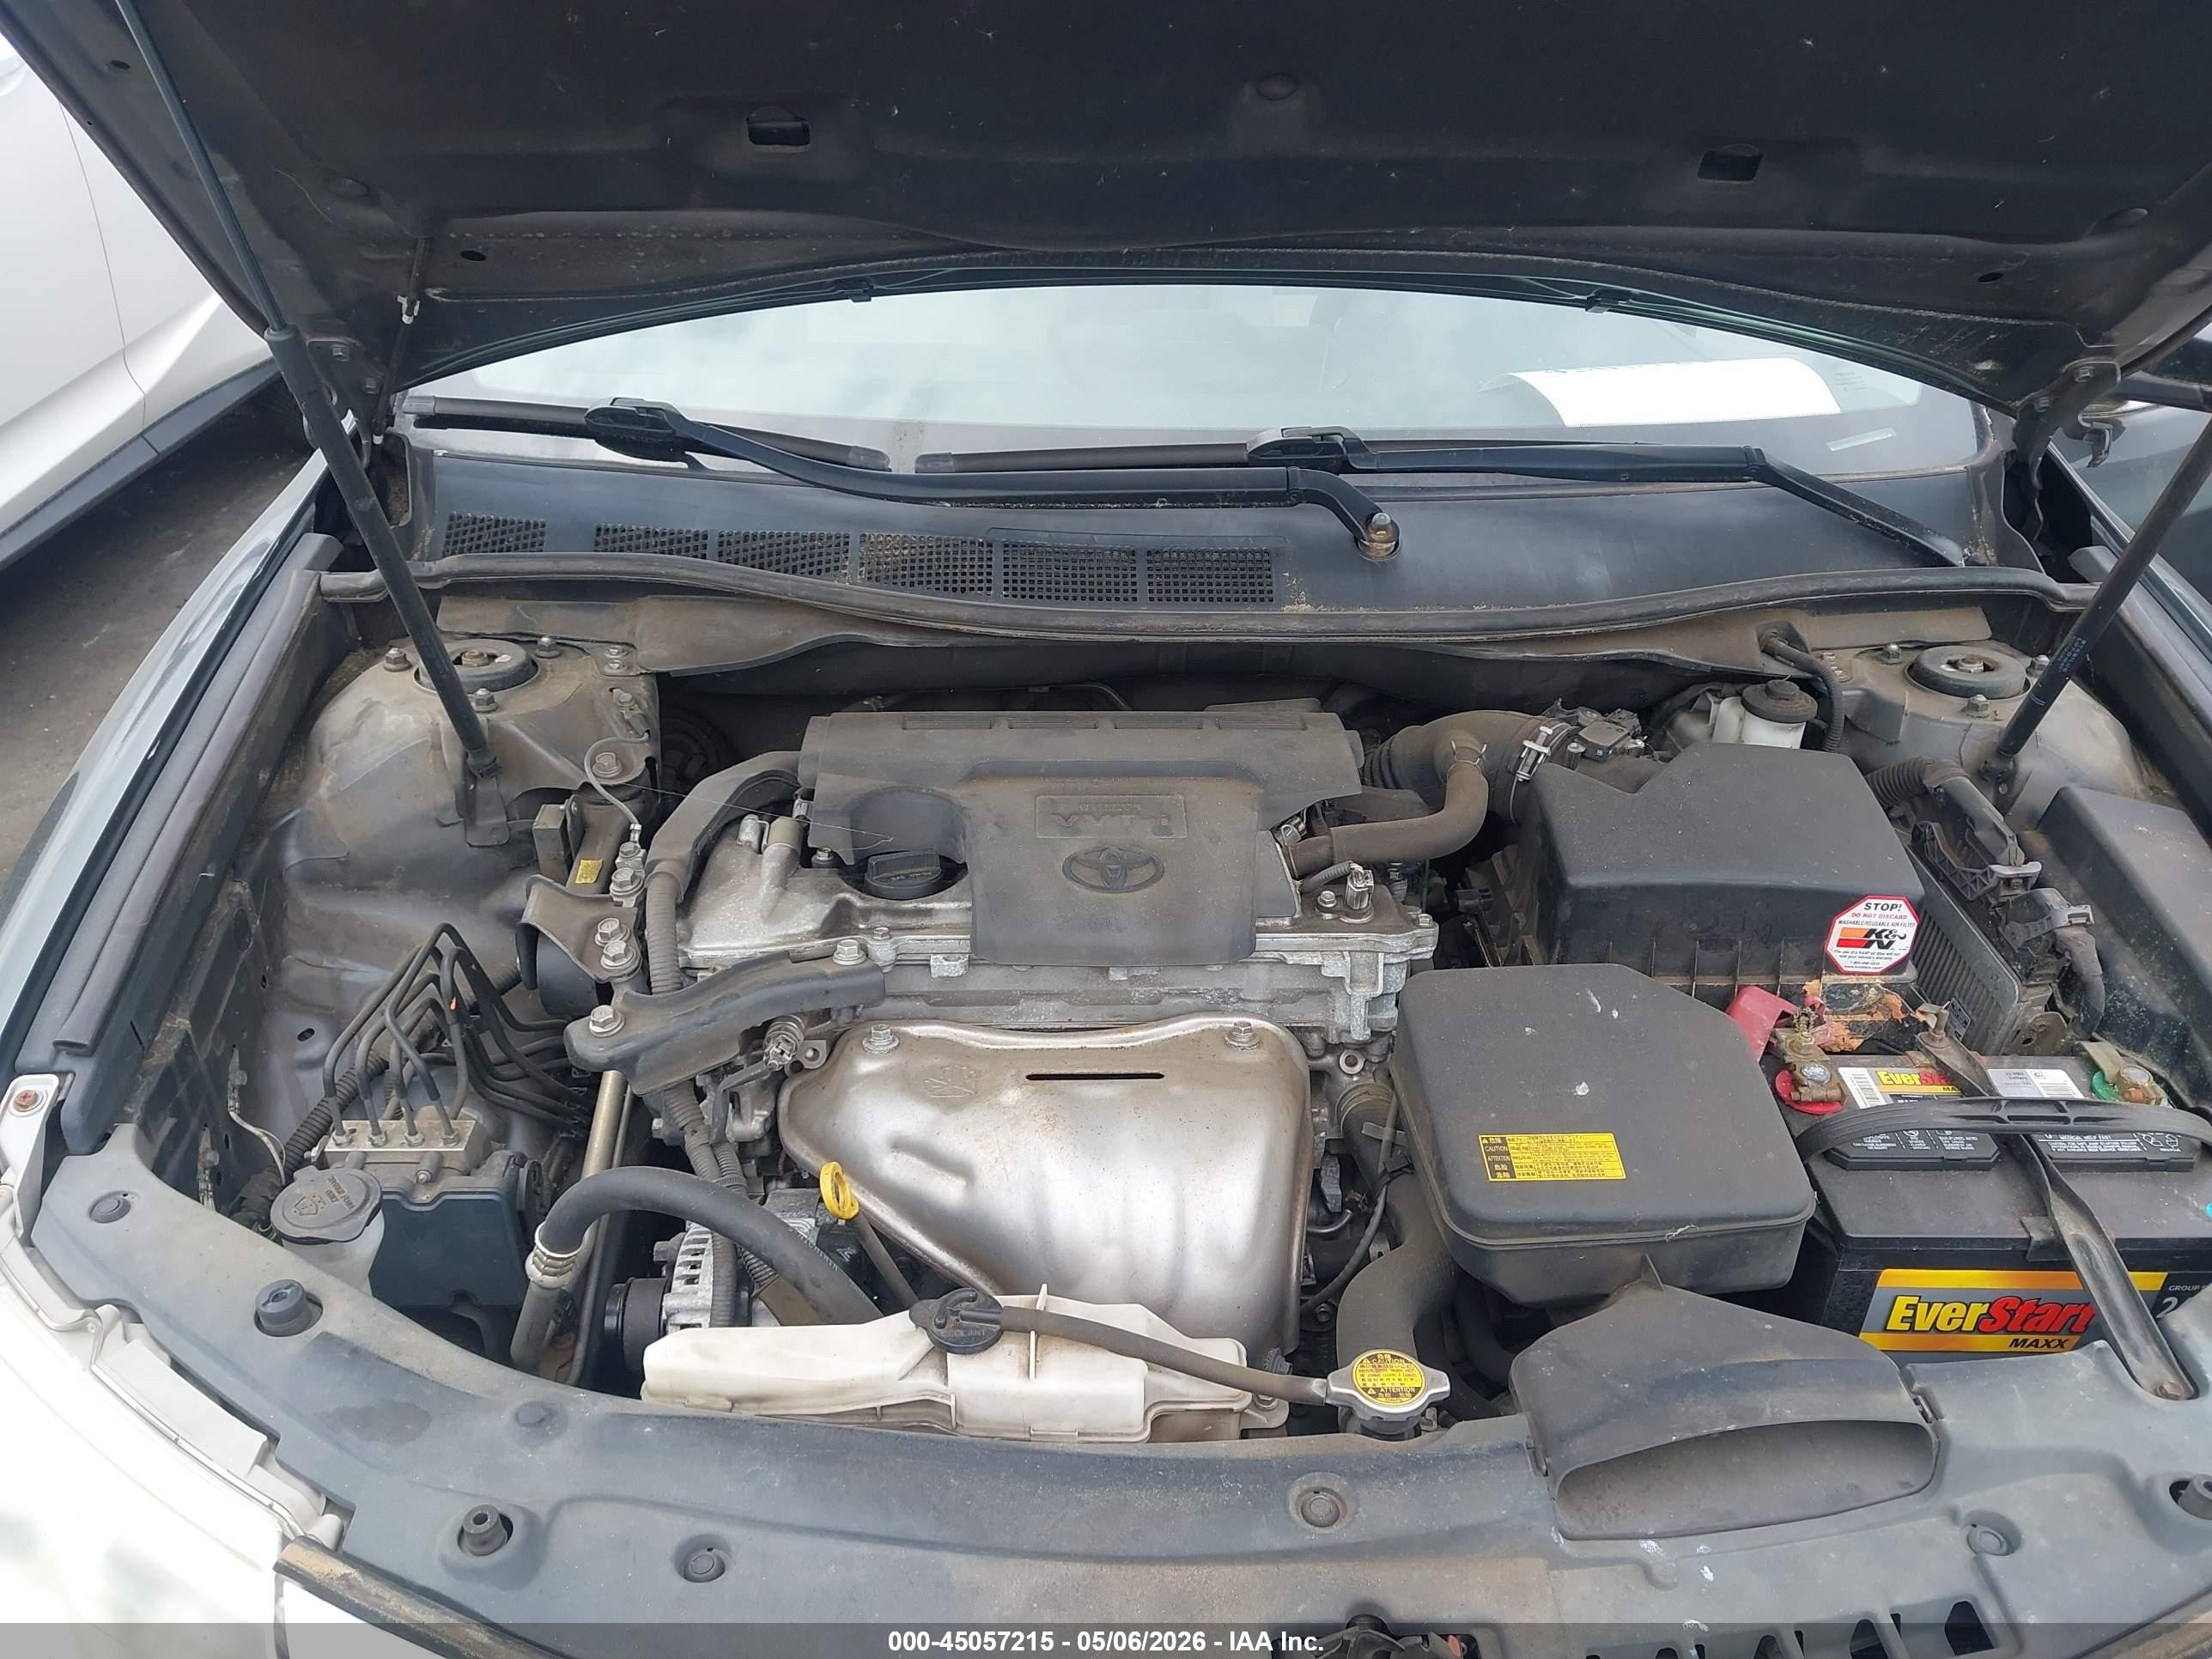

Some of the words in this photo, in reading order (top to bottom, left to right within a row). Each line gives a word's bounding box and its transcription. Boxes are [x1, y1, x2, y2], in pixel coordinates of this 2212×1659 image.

[1863, 902, 1902, 911] STOP!
[1876, 1070, 1952, 1085] EverSta
[1885, 1295, 2097, 1334] EverStart
[2008, 1337, 2069, 1349] MAXX
